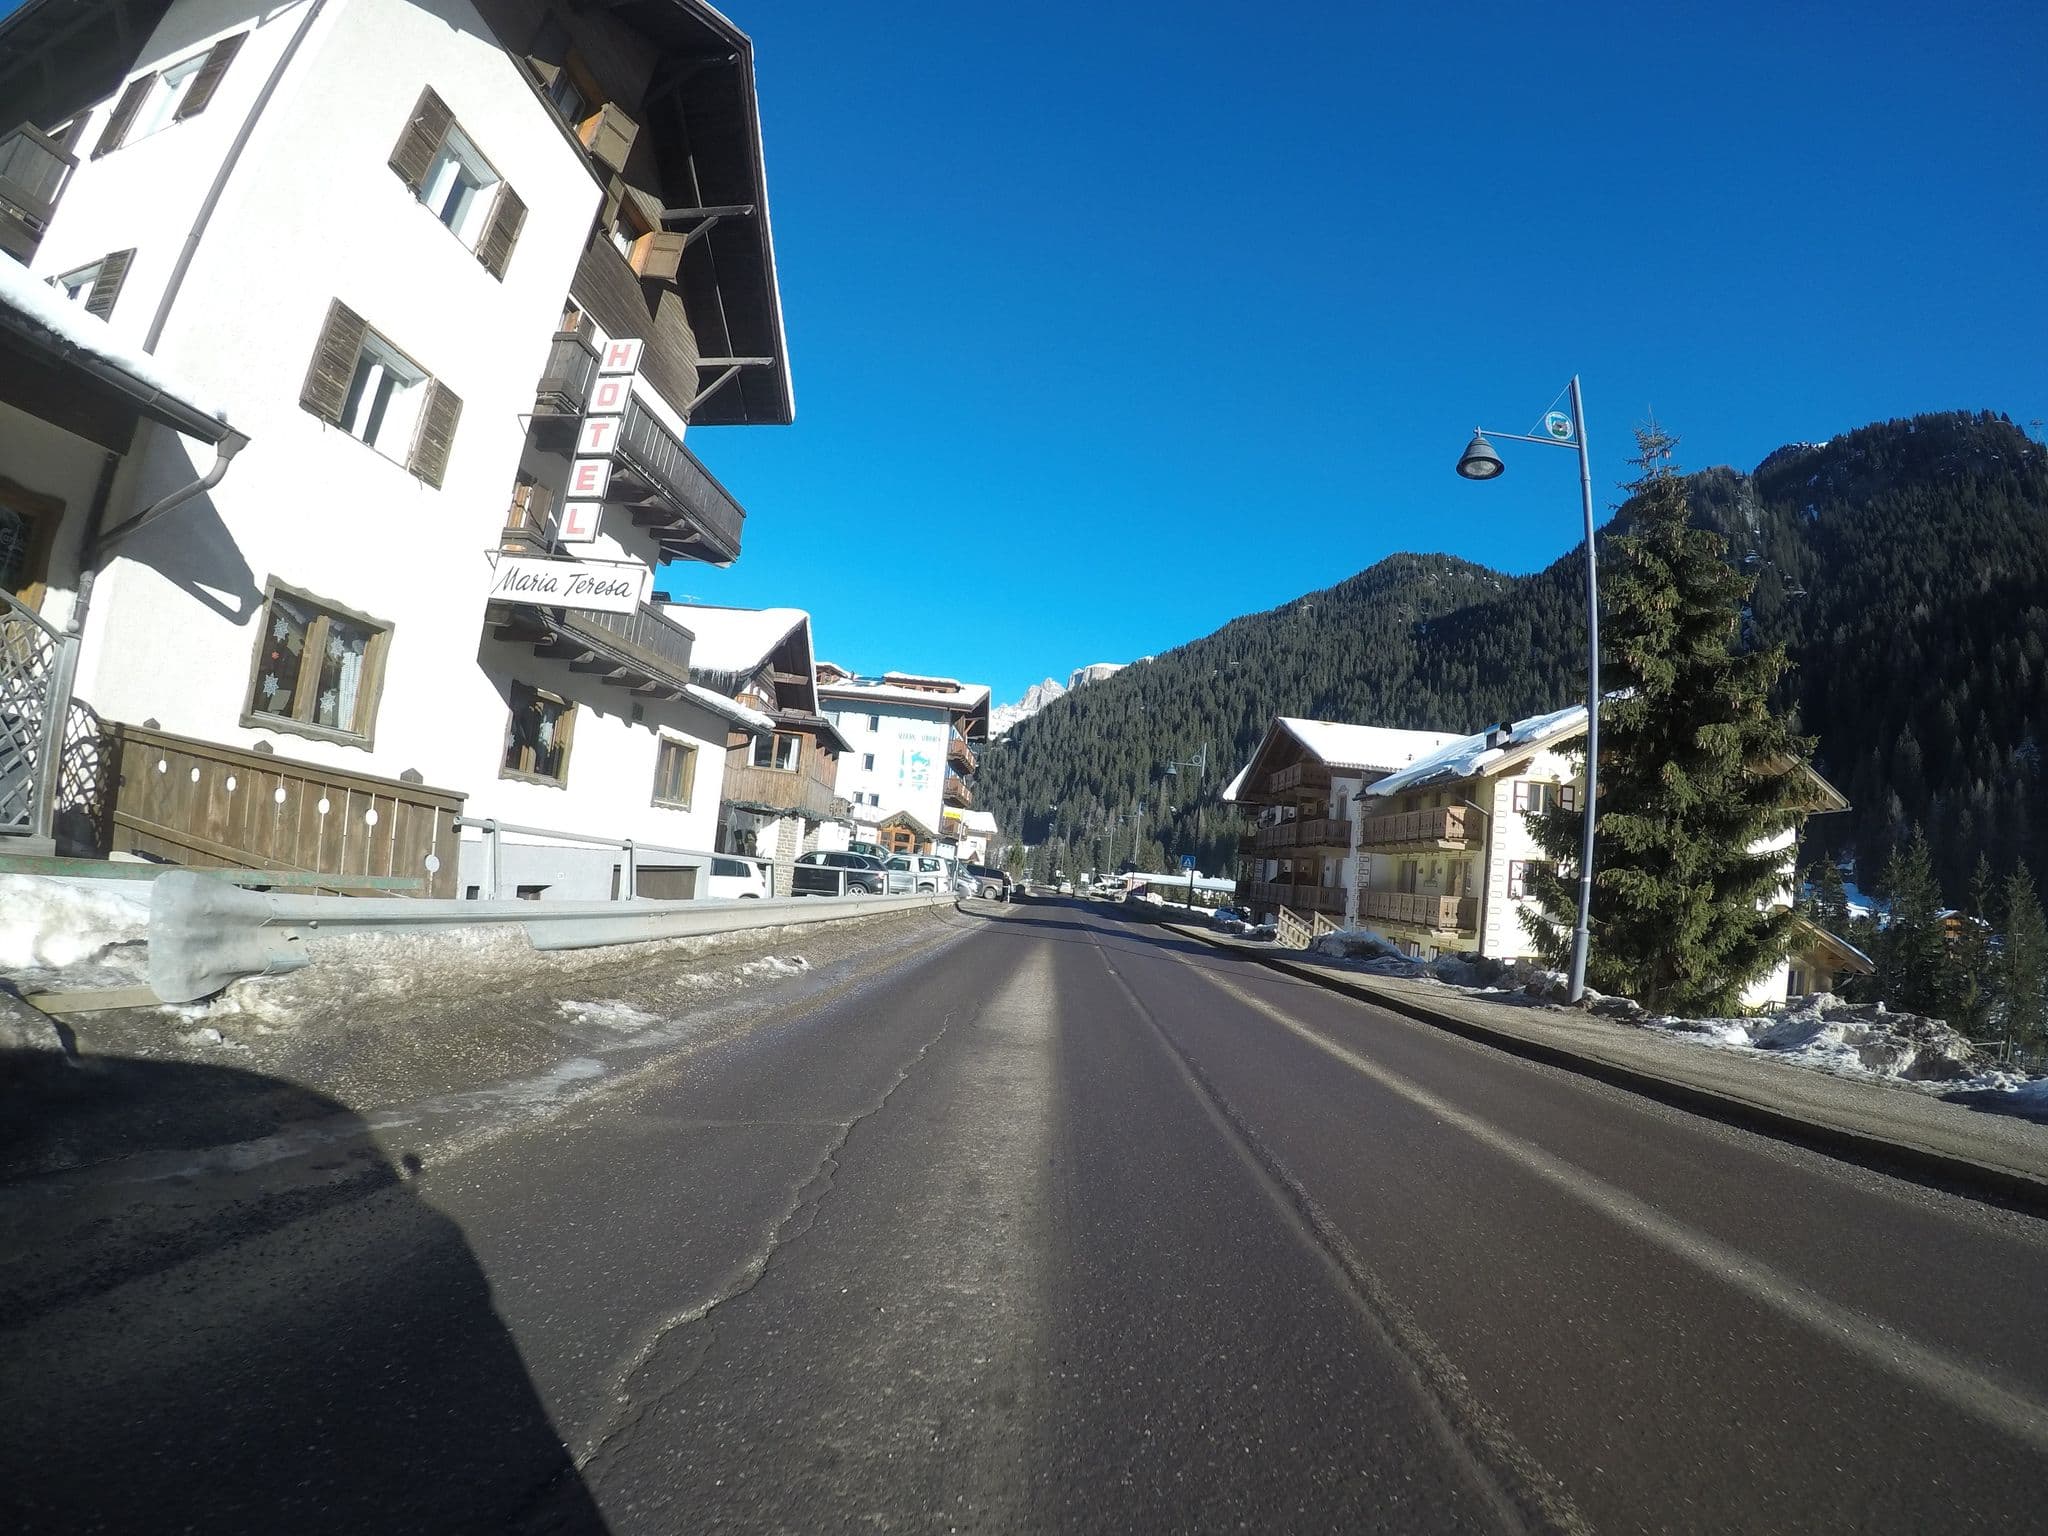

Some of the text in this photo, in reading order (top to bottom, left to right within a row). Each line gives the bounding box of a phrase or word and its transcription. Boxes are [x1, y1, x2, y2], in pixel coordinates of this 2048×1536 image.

[566, 343, 632, 535] HOTEL
[491, 565, 633, 599] Maria Teresa
